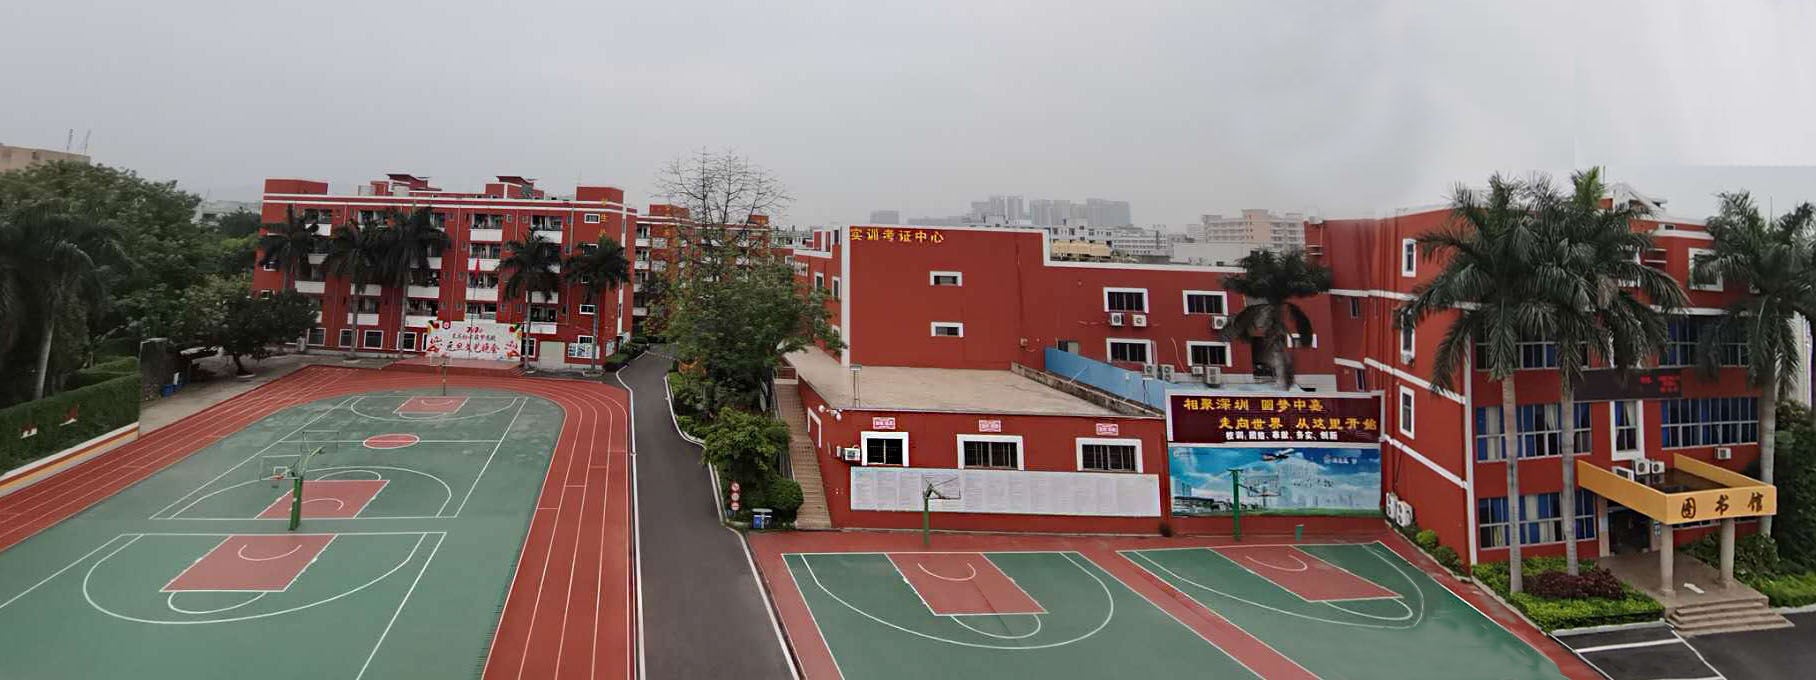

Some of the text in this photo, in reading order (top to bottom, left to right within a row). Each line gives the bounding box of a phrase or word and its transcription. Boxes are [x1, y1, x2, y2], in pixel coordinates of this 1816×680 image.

[850, 228, 944, 243] 实训考证中心
[1183, 398, 1249, 411] 相聚深圳
[1219, 417, 1377, 431] 走向世界 从这里开始
[1681, 491, 1764, 518] 图书馆
